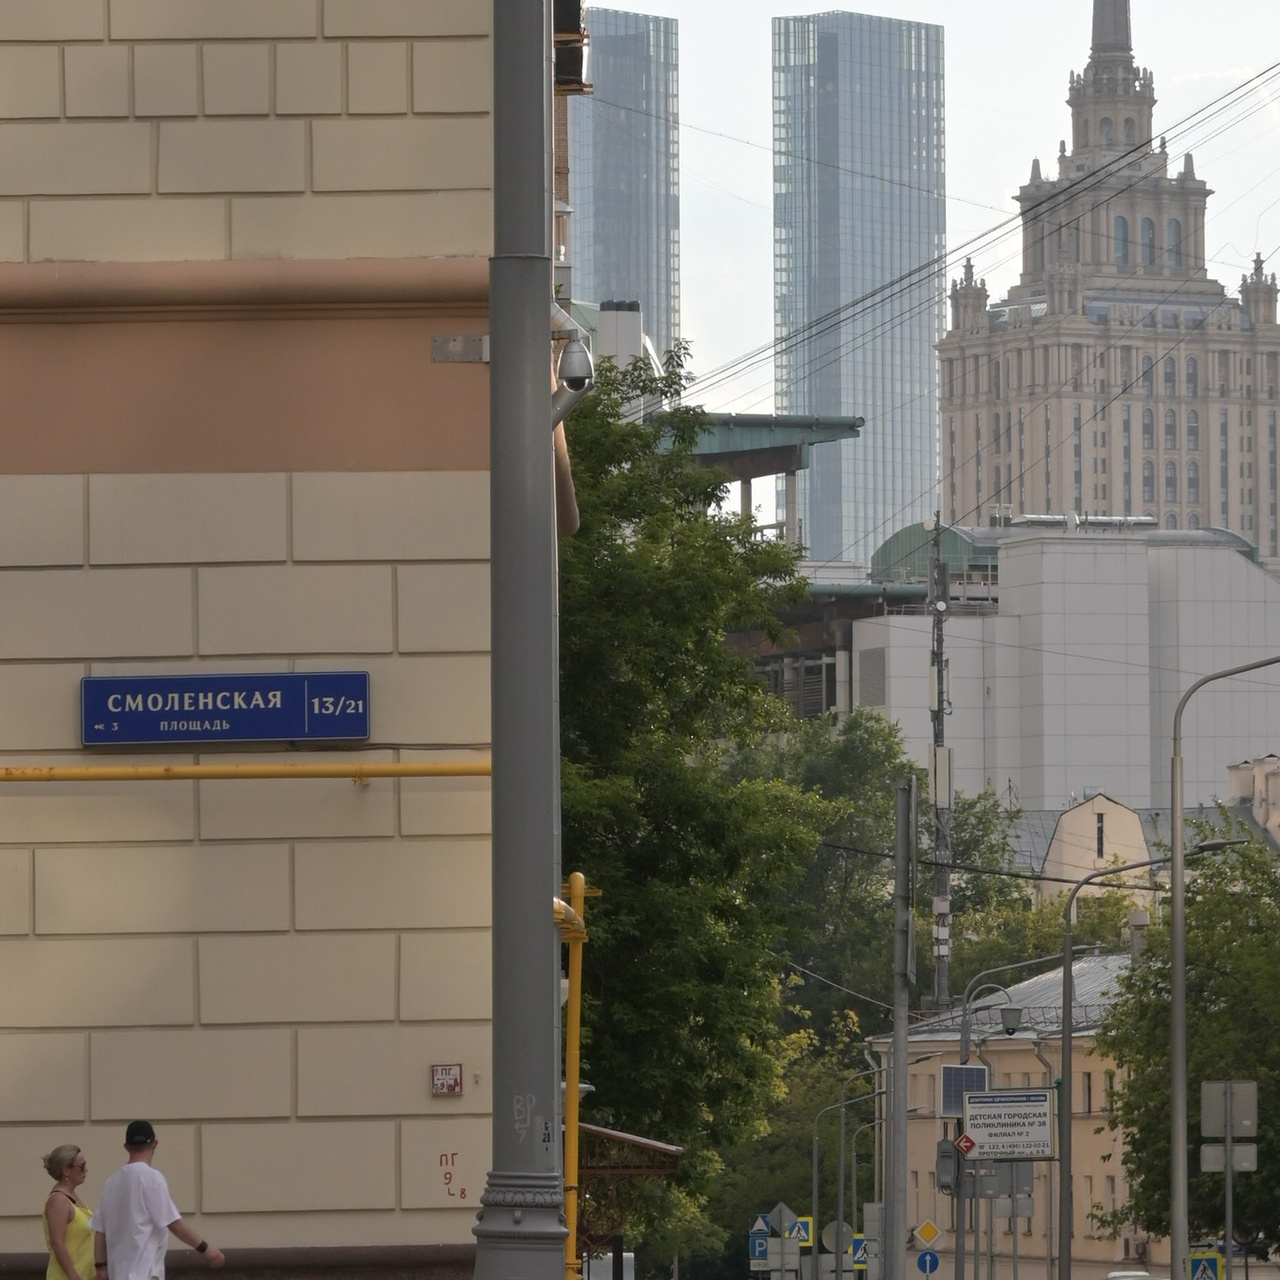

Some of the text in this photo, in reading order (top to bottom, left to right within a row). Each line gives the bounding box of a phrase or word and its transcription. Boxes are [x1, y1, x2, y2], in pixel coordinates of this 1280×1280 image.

[107, 690, 282, 713] СМОЛЕНСКАЯ
[311, 695, 364, 716] 13/21
[159, 720, 230, 732] ПЛОЩАДЬ
[969, 1111, 1048, 1121] ДЕТСКАЯ ГОРОДСКАЯ
[443, 1171, 453, 1185] 9
